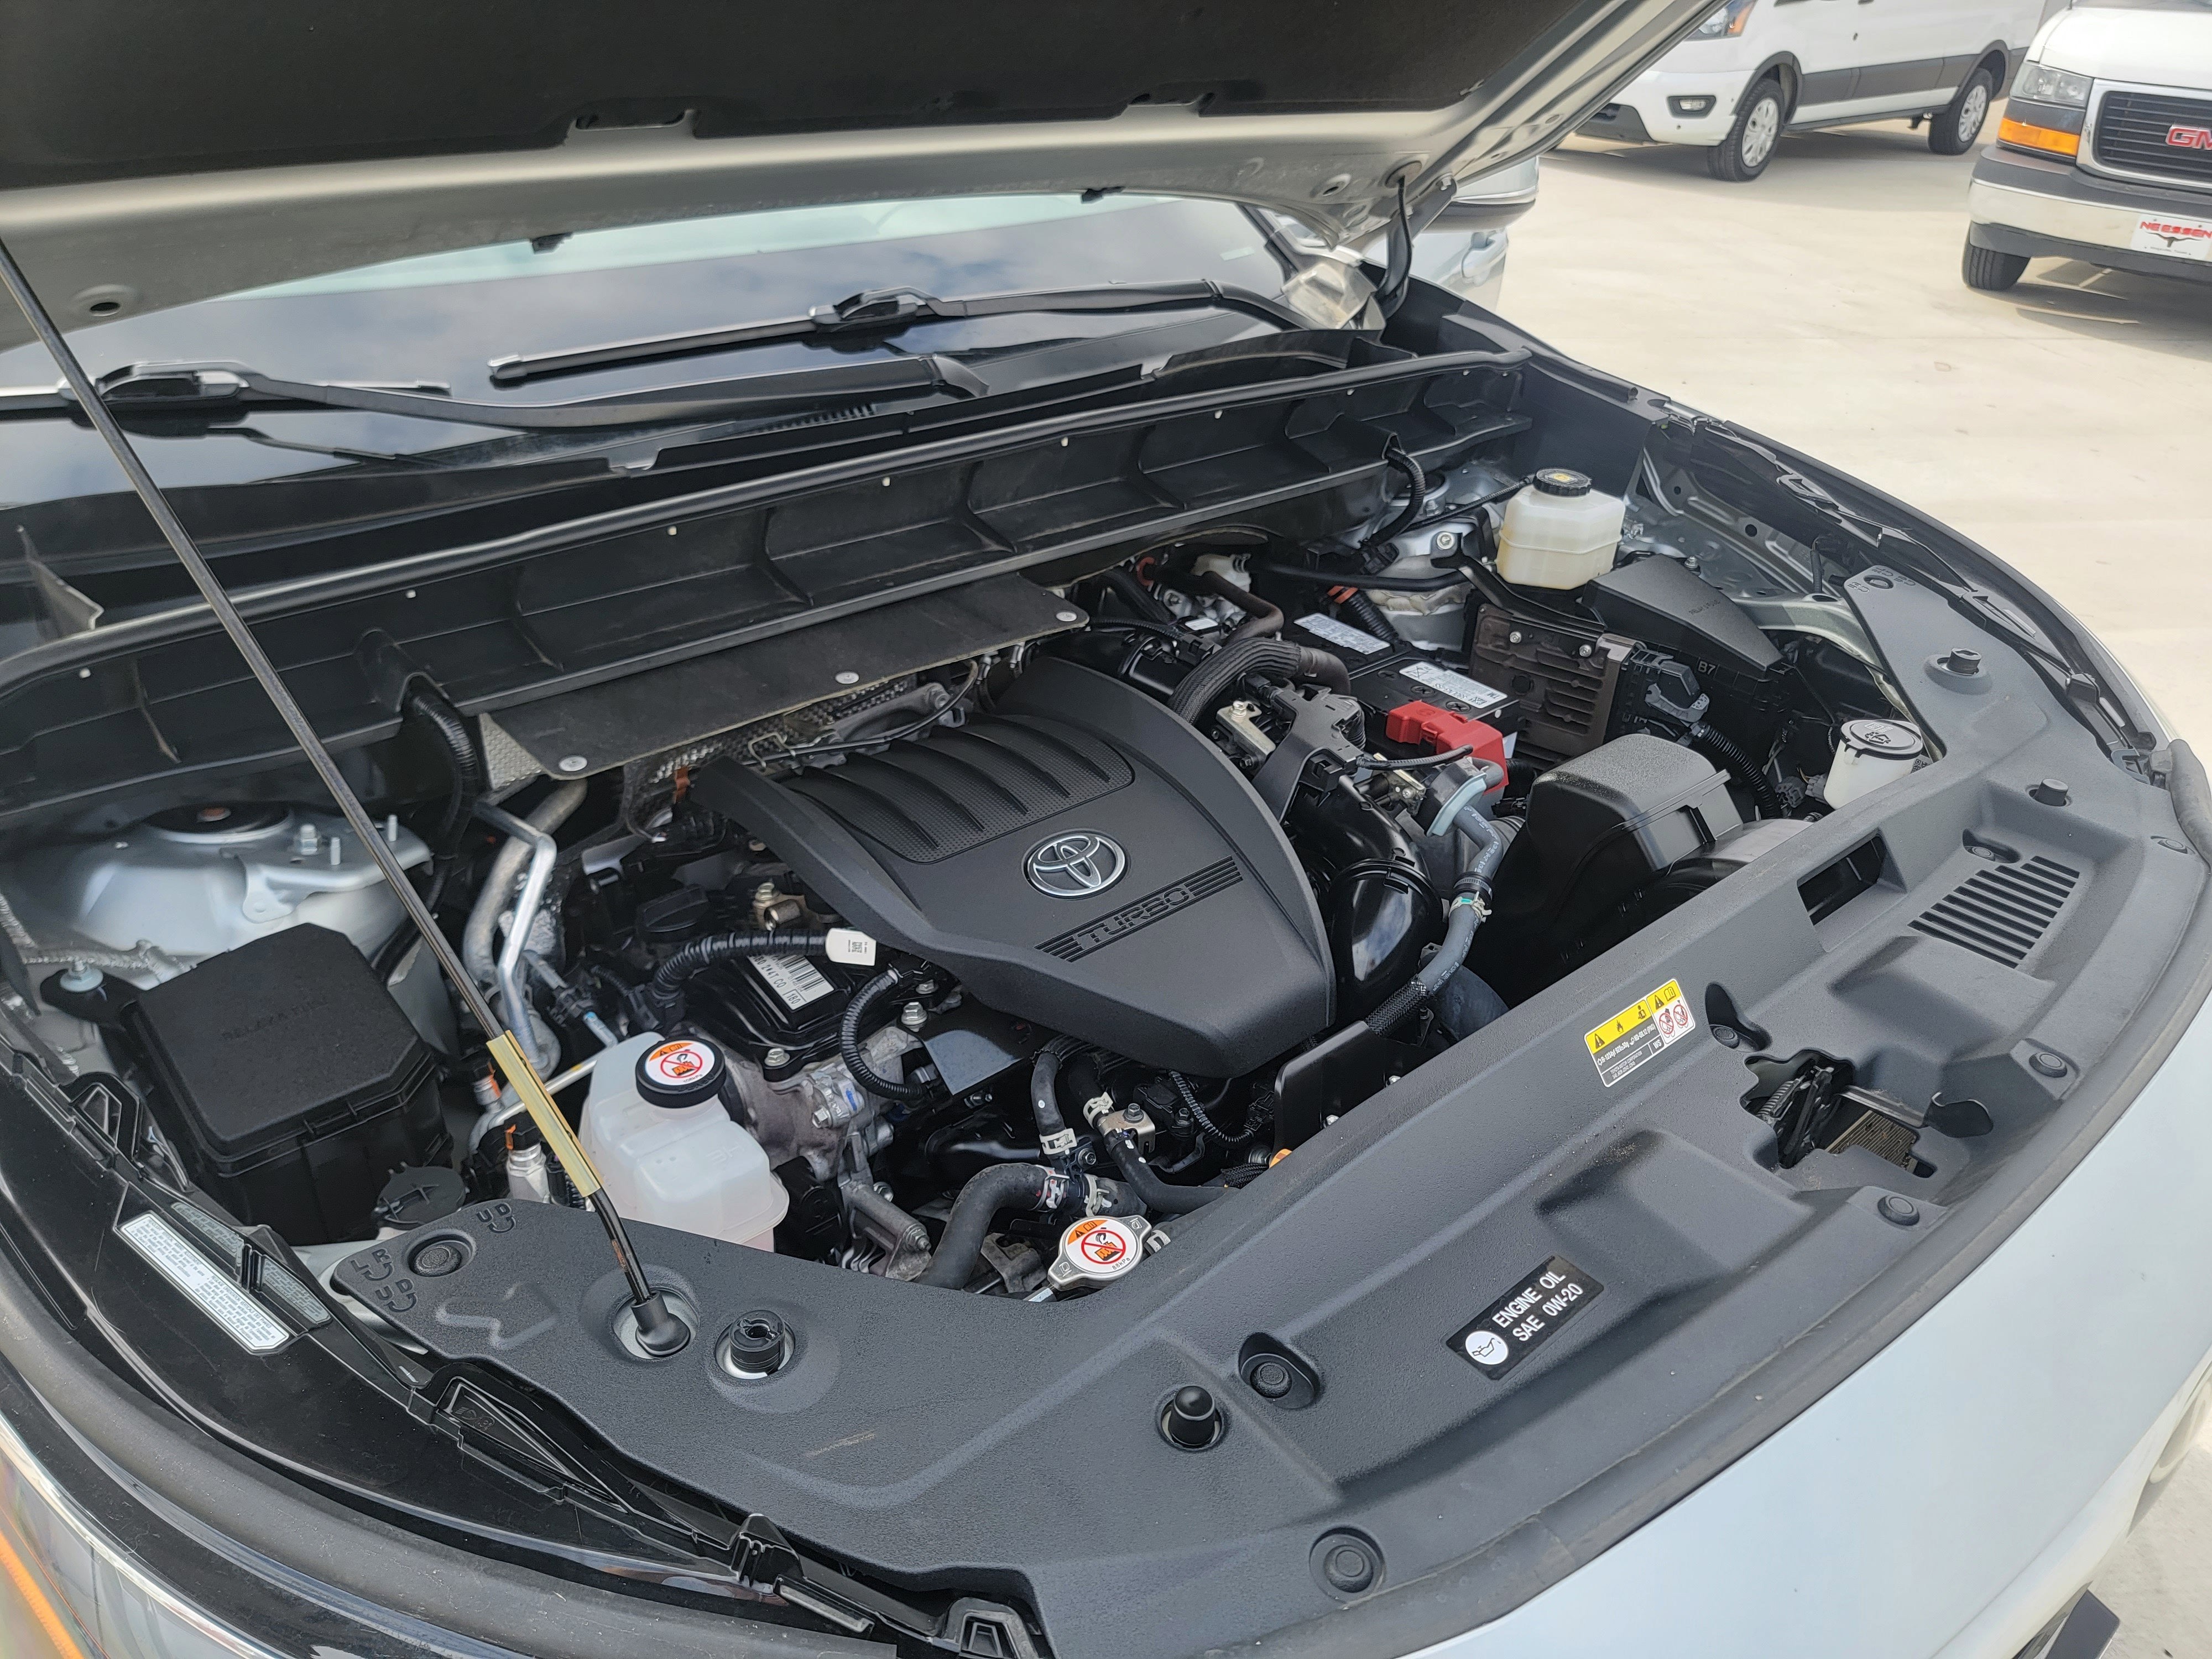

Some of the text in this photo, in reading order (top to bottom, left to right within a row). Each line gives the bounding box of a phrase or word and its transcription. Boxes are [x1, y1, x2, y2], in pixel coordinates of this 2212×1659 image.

[1698, 660, 1716, 675] B7
[1077, 887, 1190, 943] TURBO
[1652, 1040, 1661, 1049] WS
[477, 1203, 510, 1223] U D
[351, 1259, 369, 1274] L
[1112, 1257, 1130, 1270] 88kPa
[375, 1279, 414, 1300] U D
[1492, 1271, 1567, 1328] ENGINE OIL
[1512, 1282, 1584, 1342] SAE 0W-20
